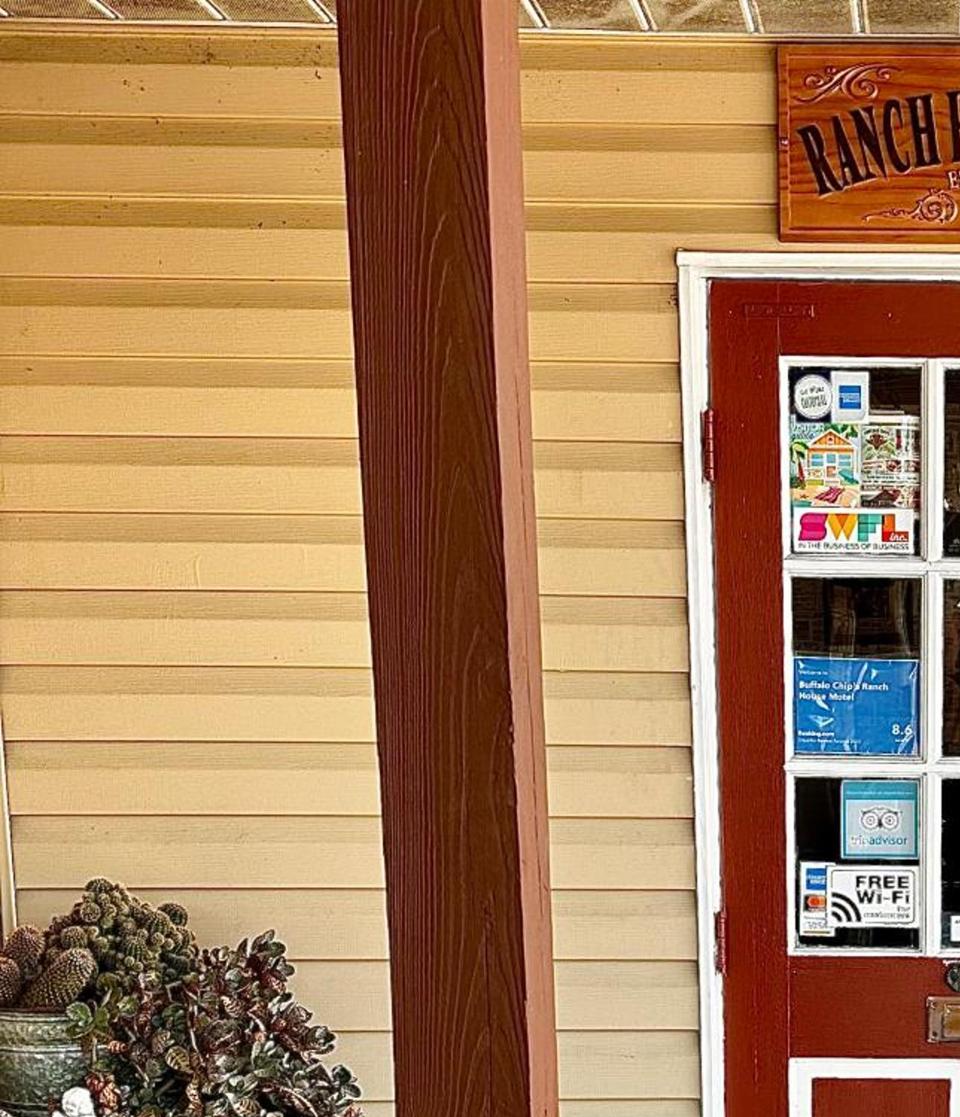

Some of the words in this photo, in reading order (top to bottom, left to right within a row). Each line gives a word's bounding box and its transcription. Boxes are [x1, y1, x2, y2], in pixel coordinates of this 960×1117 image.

[796, 92, 941, 197] RANCH
[798, 512, 909, 542] SWFL
[808, 541, 821, 549] THE
[823, 542, 859, 550] BUSINESS
[873, 543, 909, 551] BUSINESS
[800, 681, 831, 690] Buffalo
[862, 682, 889, 691] Ranch
[829, 693, 855, 702] Motel
[892, 724, 913, 735] 8.6
[856, 875, 910, 890] FREE
[857, 890, 910, 905] Wi-Fi
